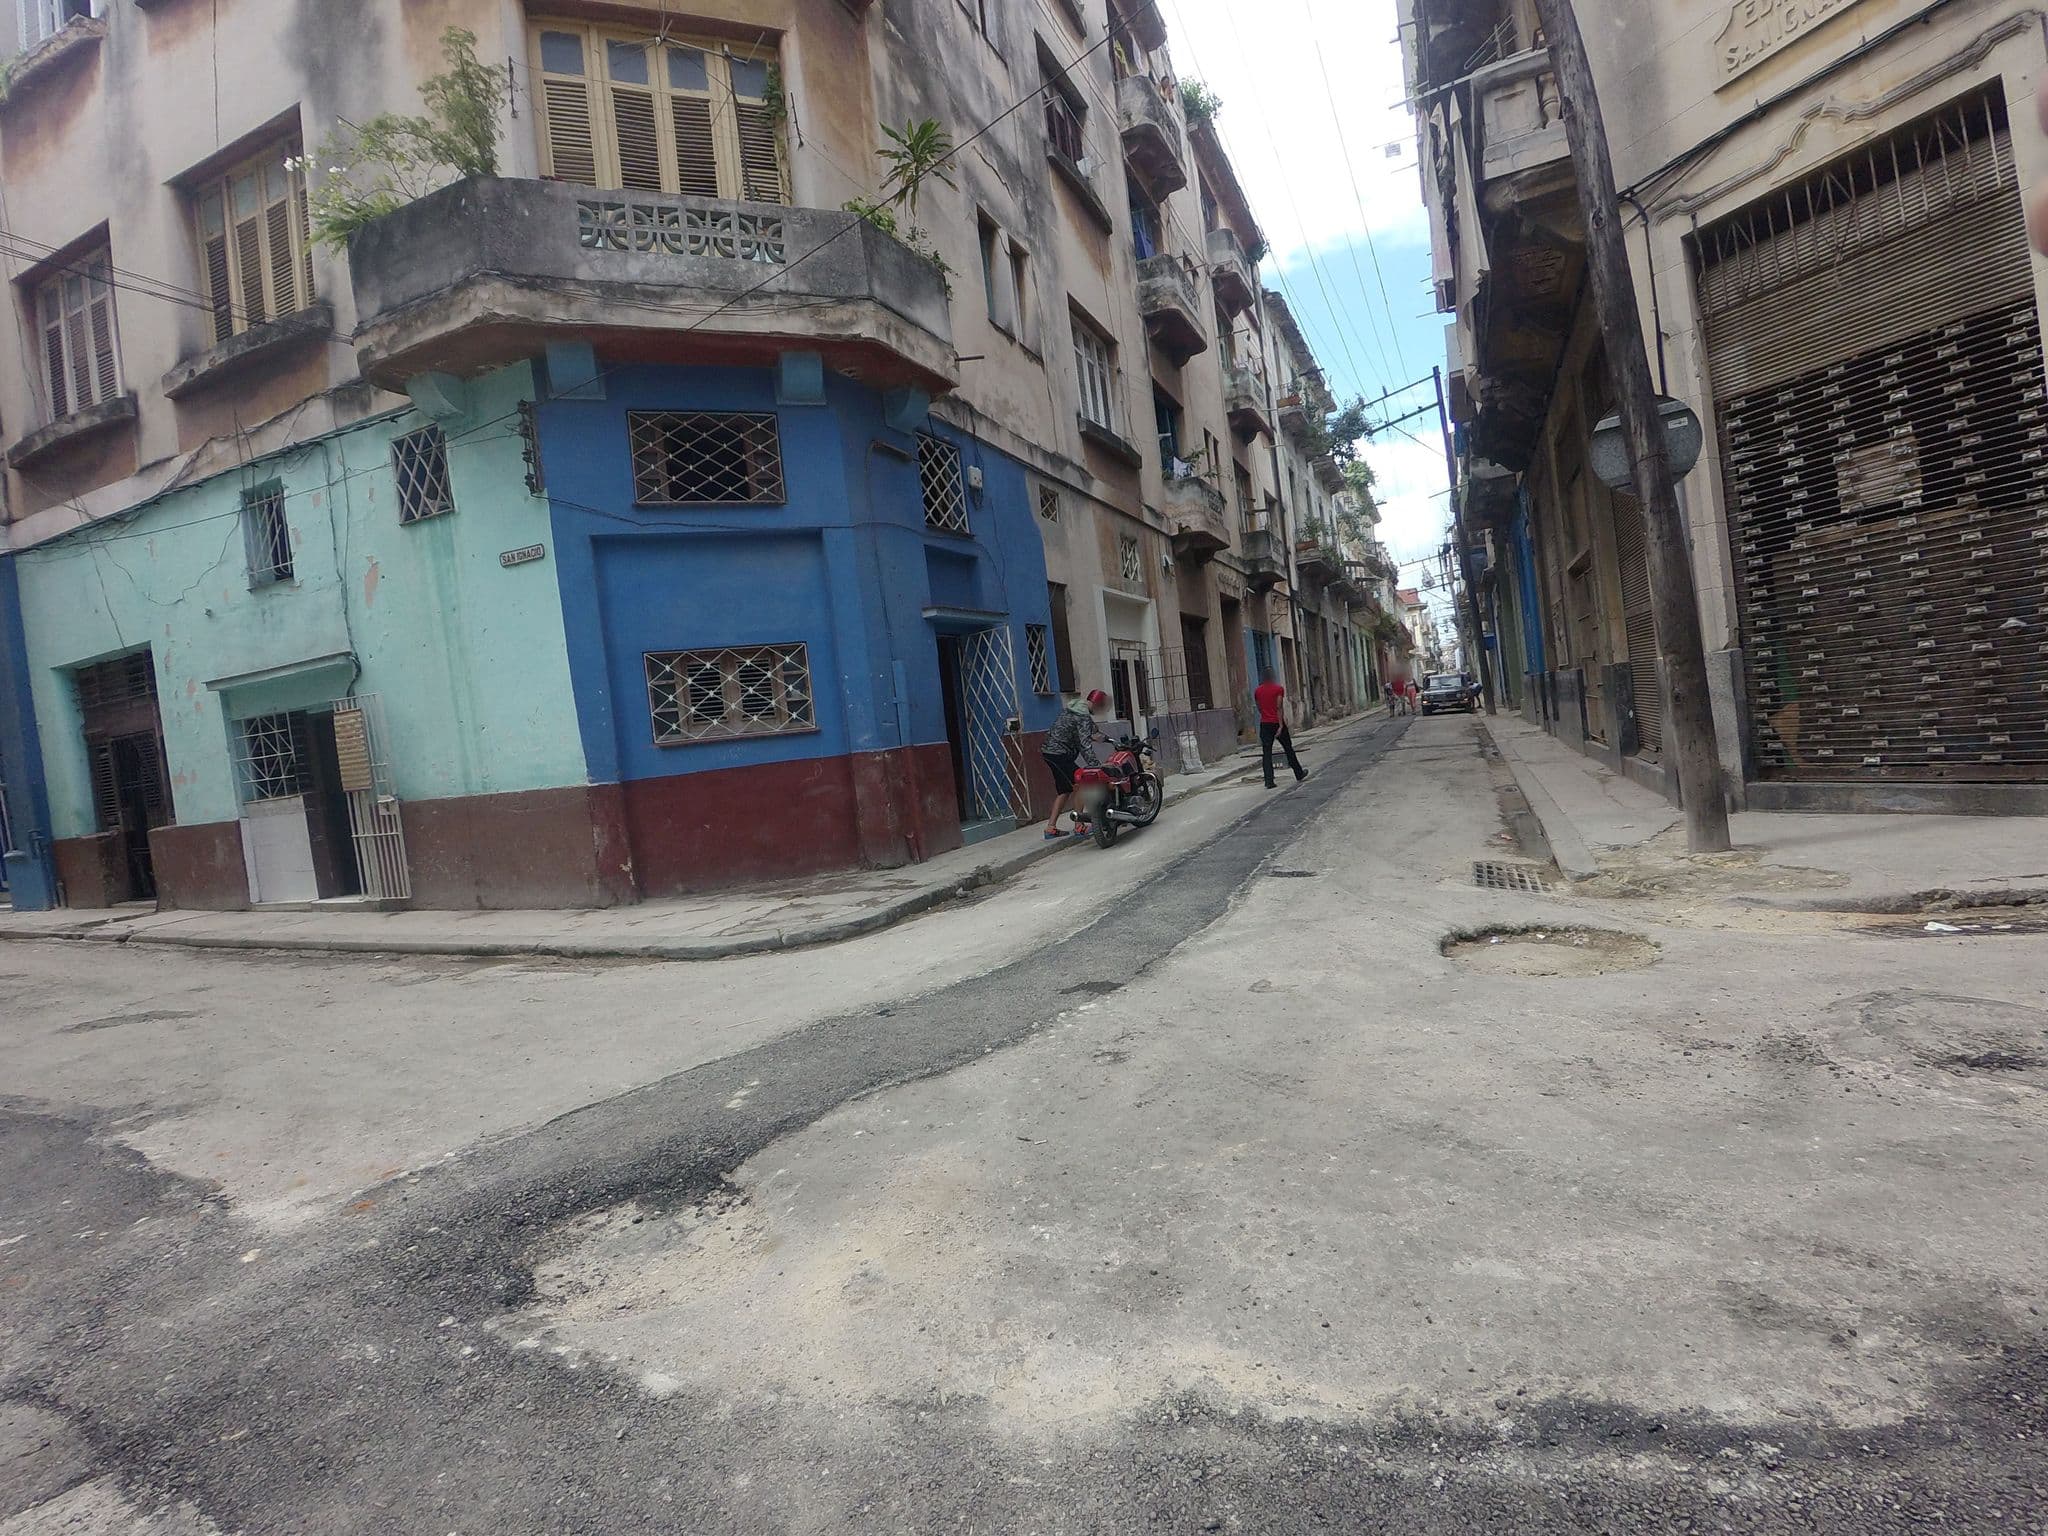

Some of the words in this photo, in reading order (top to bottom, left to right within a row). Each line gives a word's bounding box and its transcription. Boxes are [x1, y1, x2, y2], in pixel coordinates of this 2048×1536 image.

[1726, 20, 1771, 74] SAN
[502, 553, 516, 565] SAN
[516, 546, 542, 561] IGNACIO
